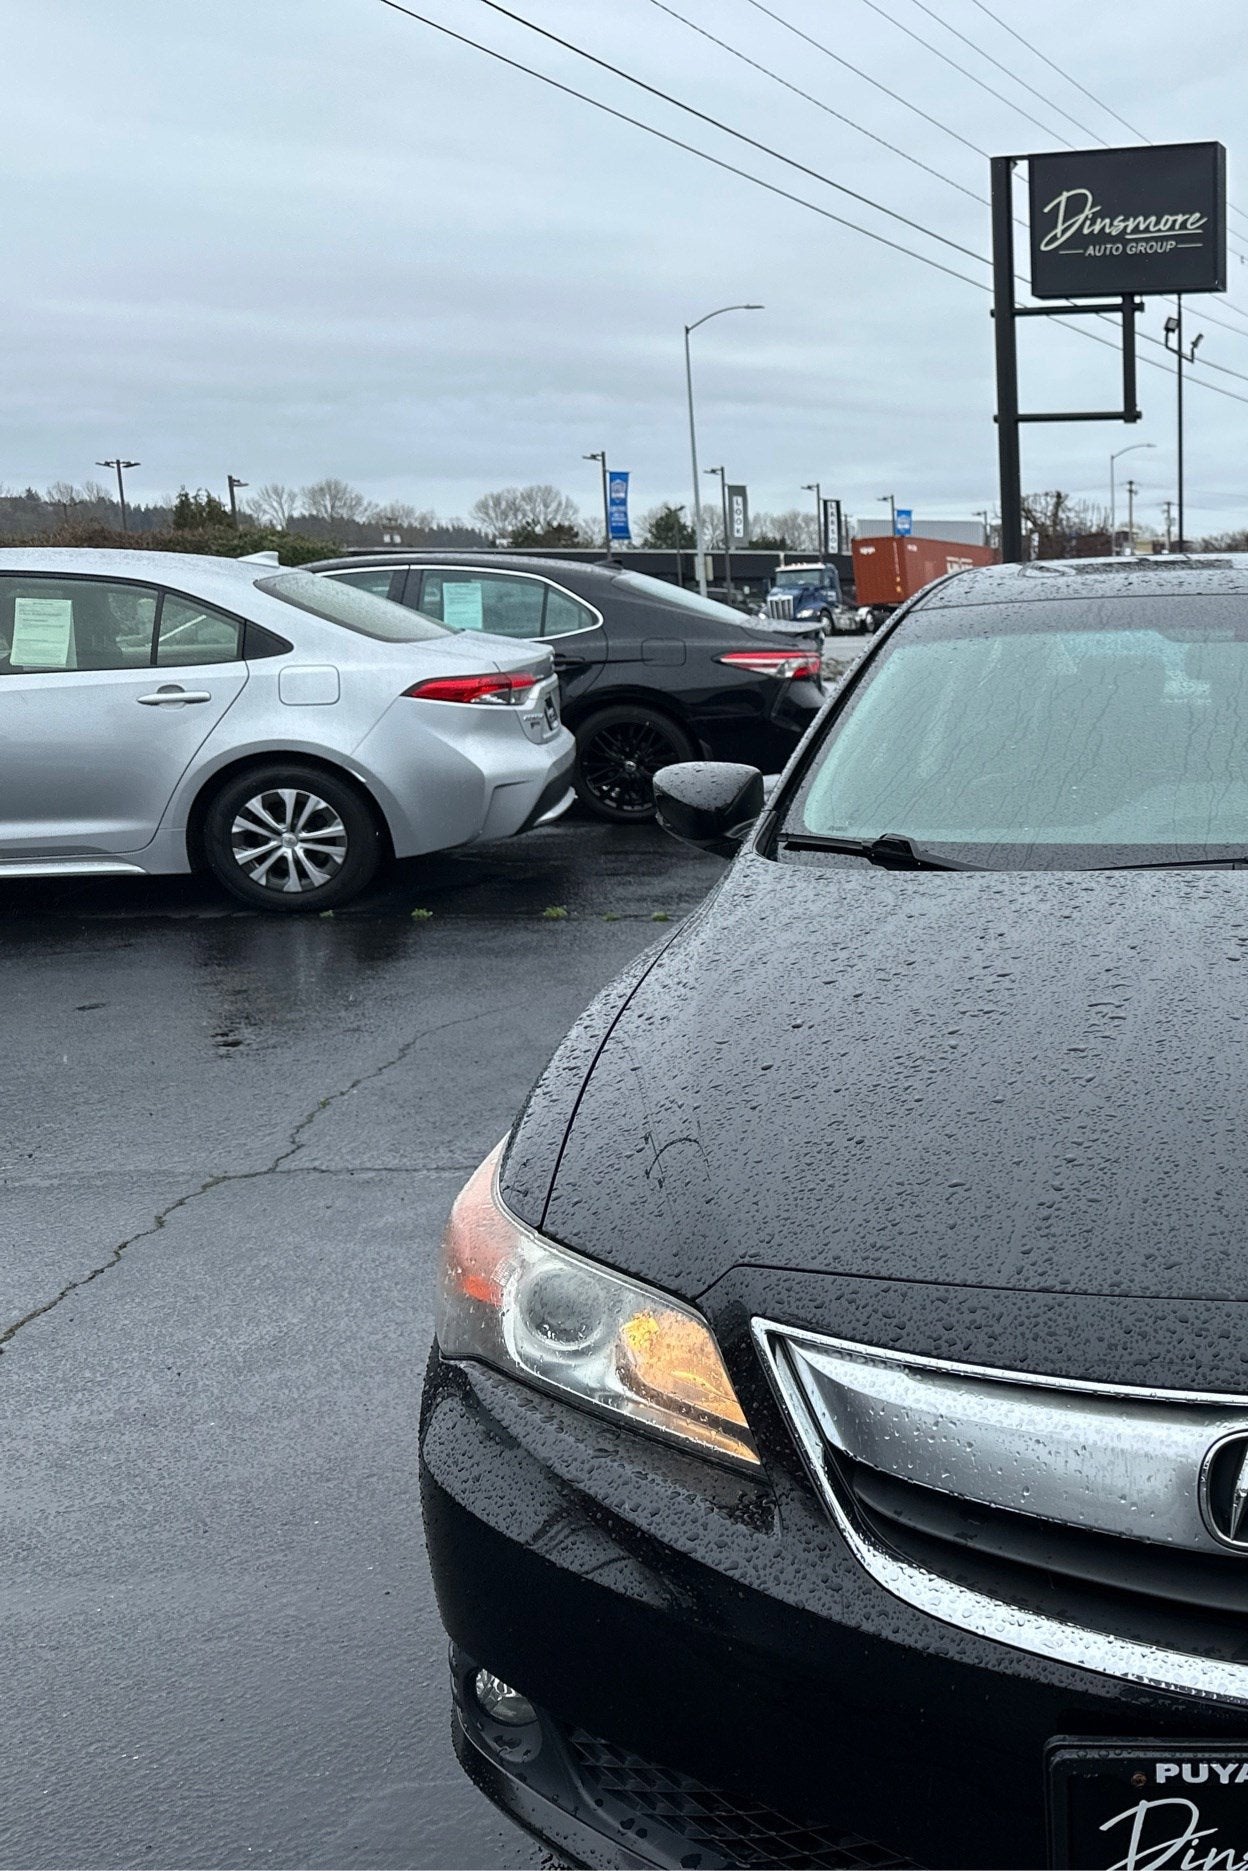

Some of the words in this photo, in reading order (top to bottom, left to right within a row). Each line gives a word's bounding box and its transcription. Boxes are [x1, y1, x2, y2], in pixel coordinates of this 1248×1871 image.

[1040, 188, 1208, 251] Dinsmore
[1085, 243, 1123, 257] AUTO
[1126, 240, 1176, 255] GROUP
